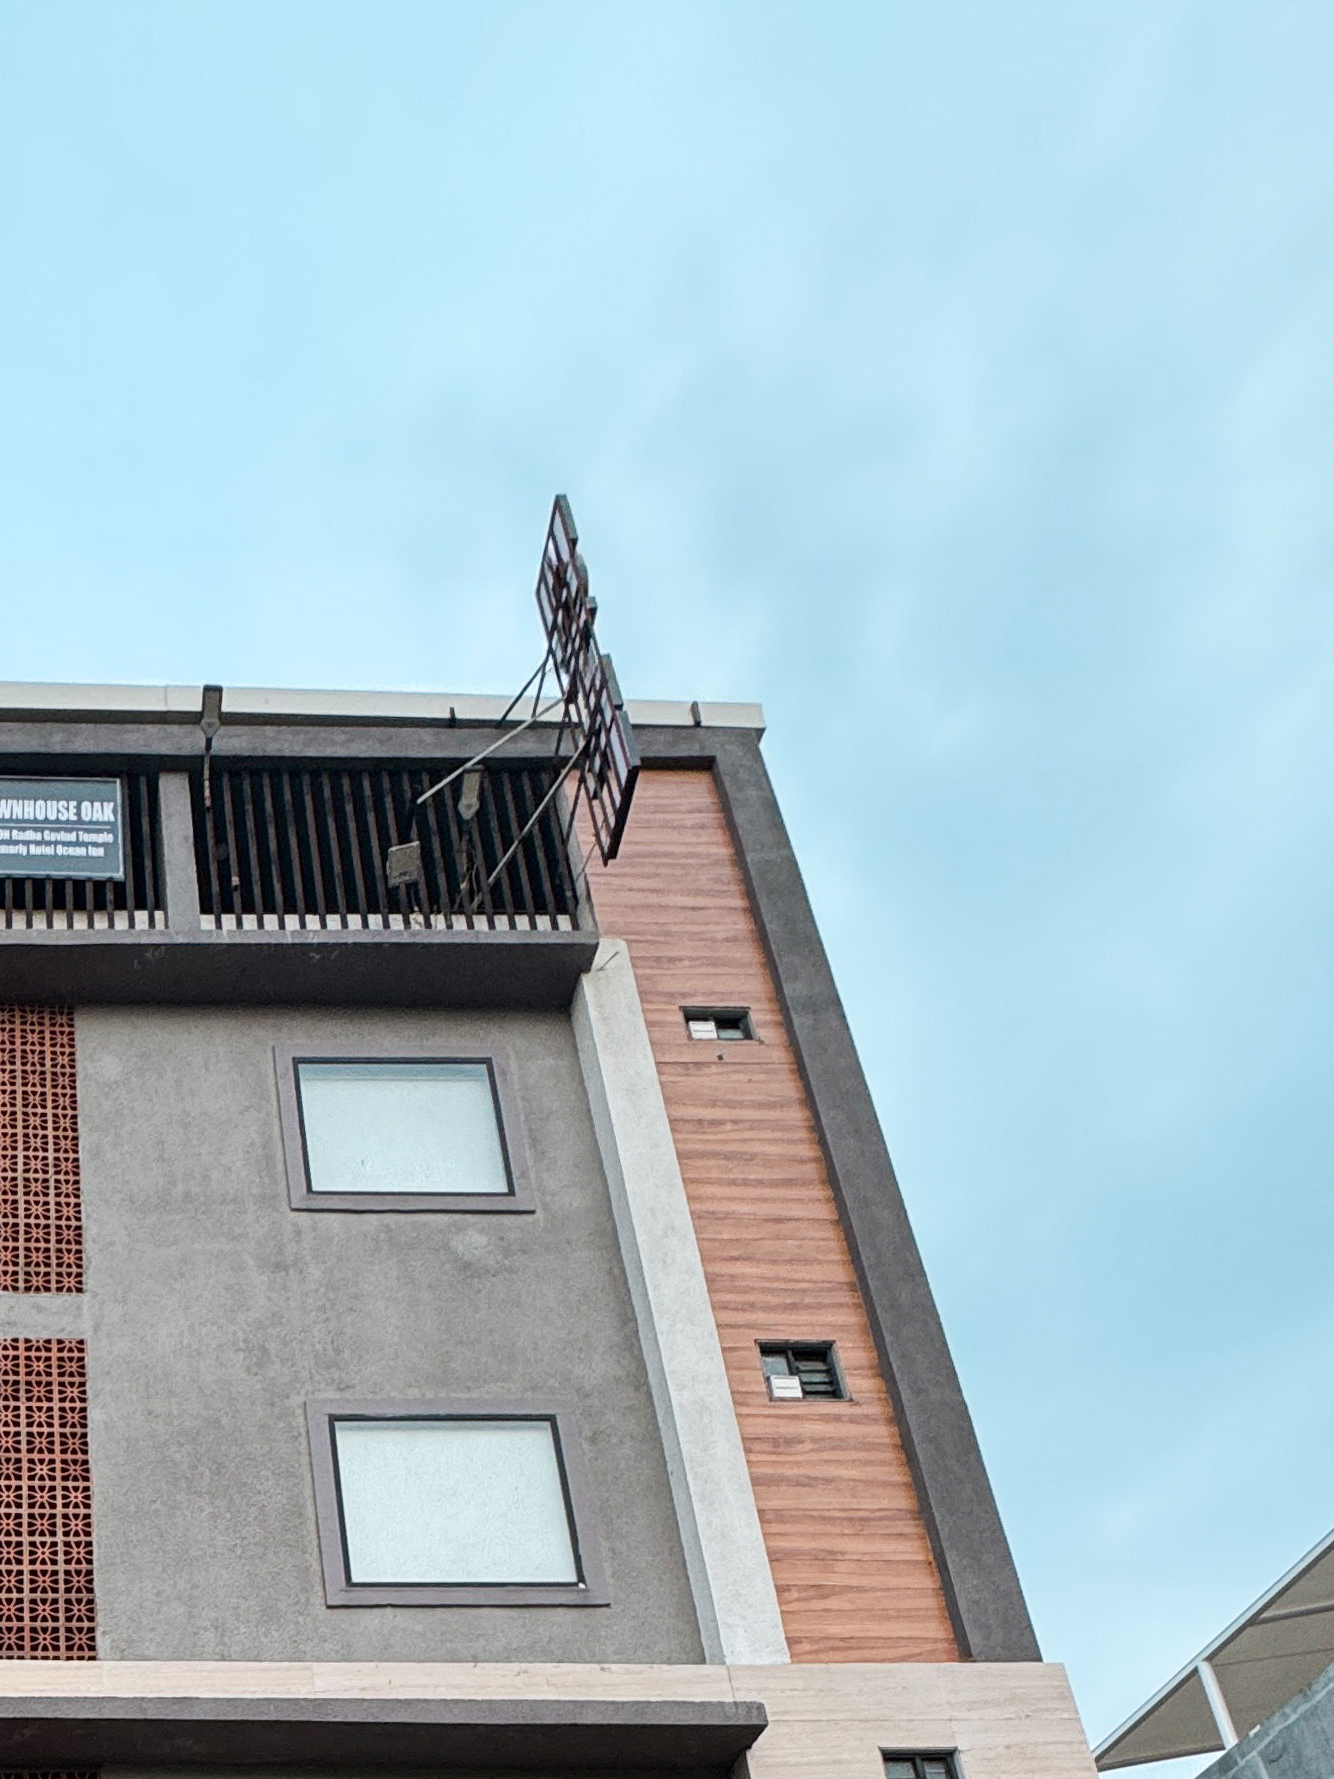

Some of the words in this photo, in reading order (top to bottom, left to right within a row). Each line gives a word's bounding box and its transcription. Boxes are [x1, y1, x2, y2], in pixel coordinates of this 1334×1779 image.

[80, 800, 115, 822] OAK
[78, 831, 114, 843] Temple
[29, 843, 55, 856] Hotel
